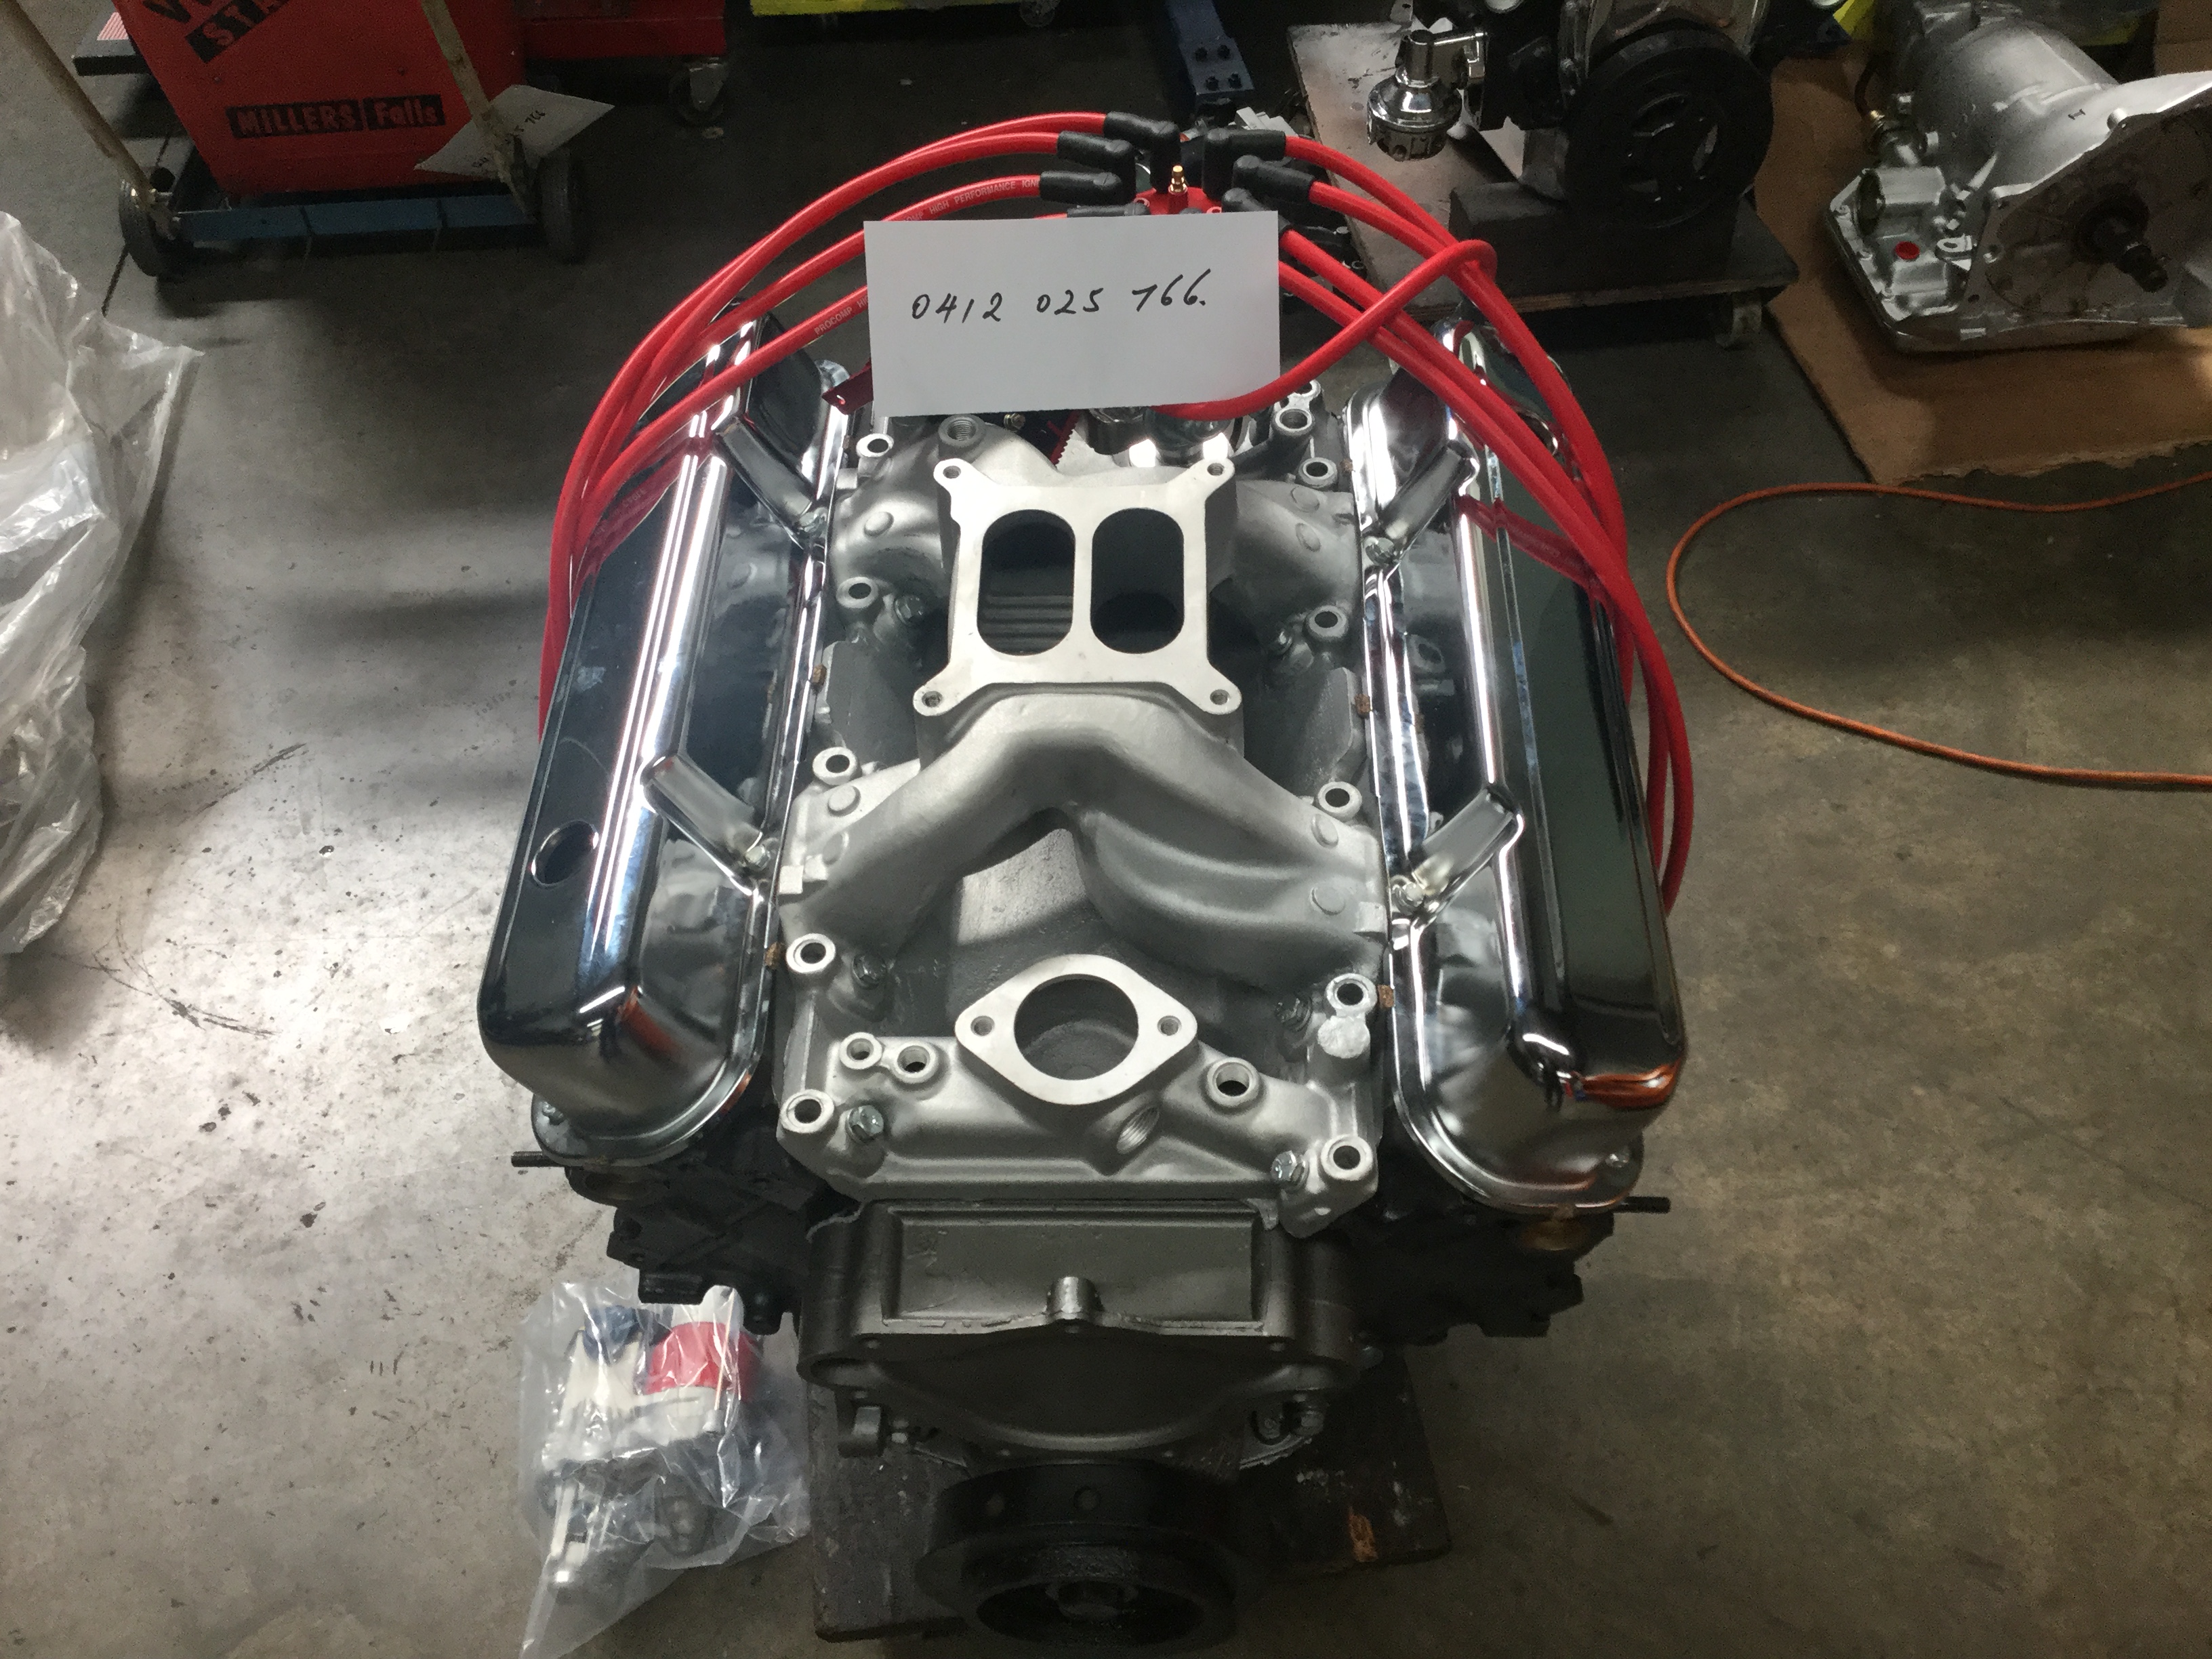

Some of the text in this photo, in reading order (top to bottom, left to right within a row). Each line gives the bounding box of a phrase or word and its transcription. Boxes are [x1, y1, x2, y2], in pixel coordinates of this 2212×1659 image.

[237, 98, 438, 134] MILLERS Falls
[928, 200, 949, 214] HIGH
[954, 180, 1016, 205] PERFORMANCE
[814, 306, 853, 335] PROCOMP
[911, 291, 1003, 323] 0412
[1036, 287, 1104, 314] 025
